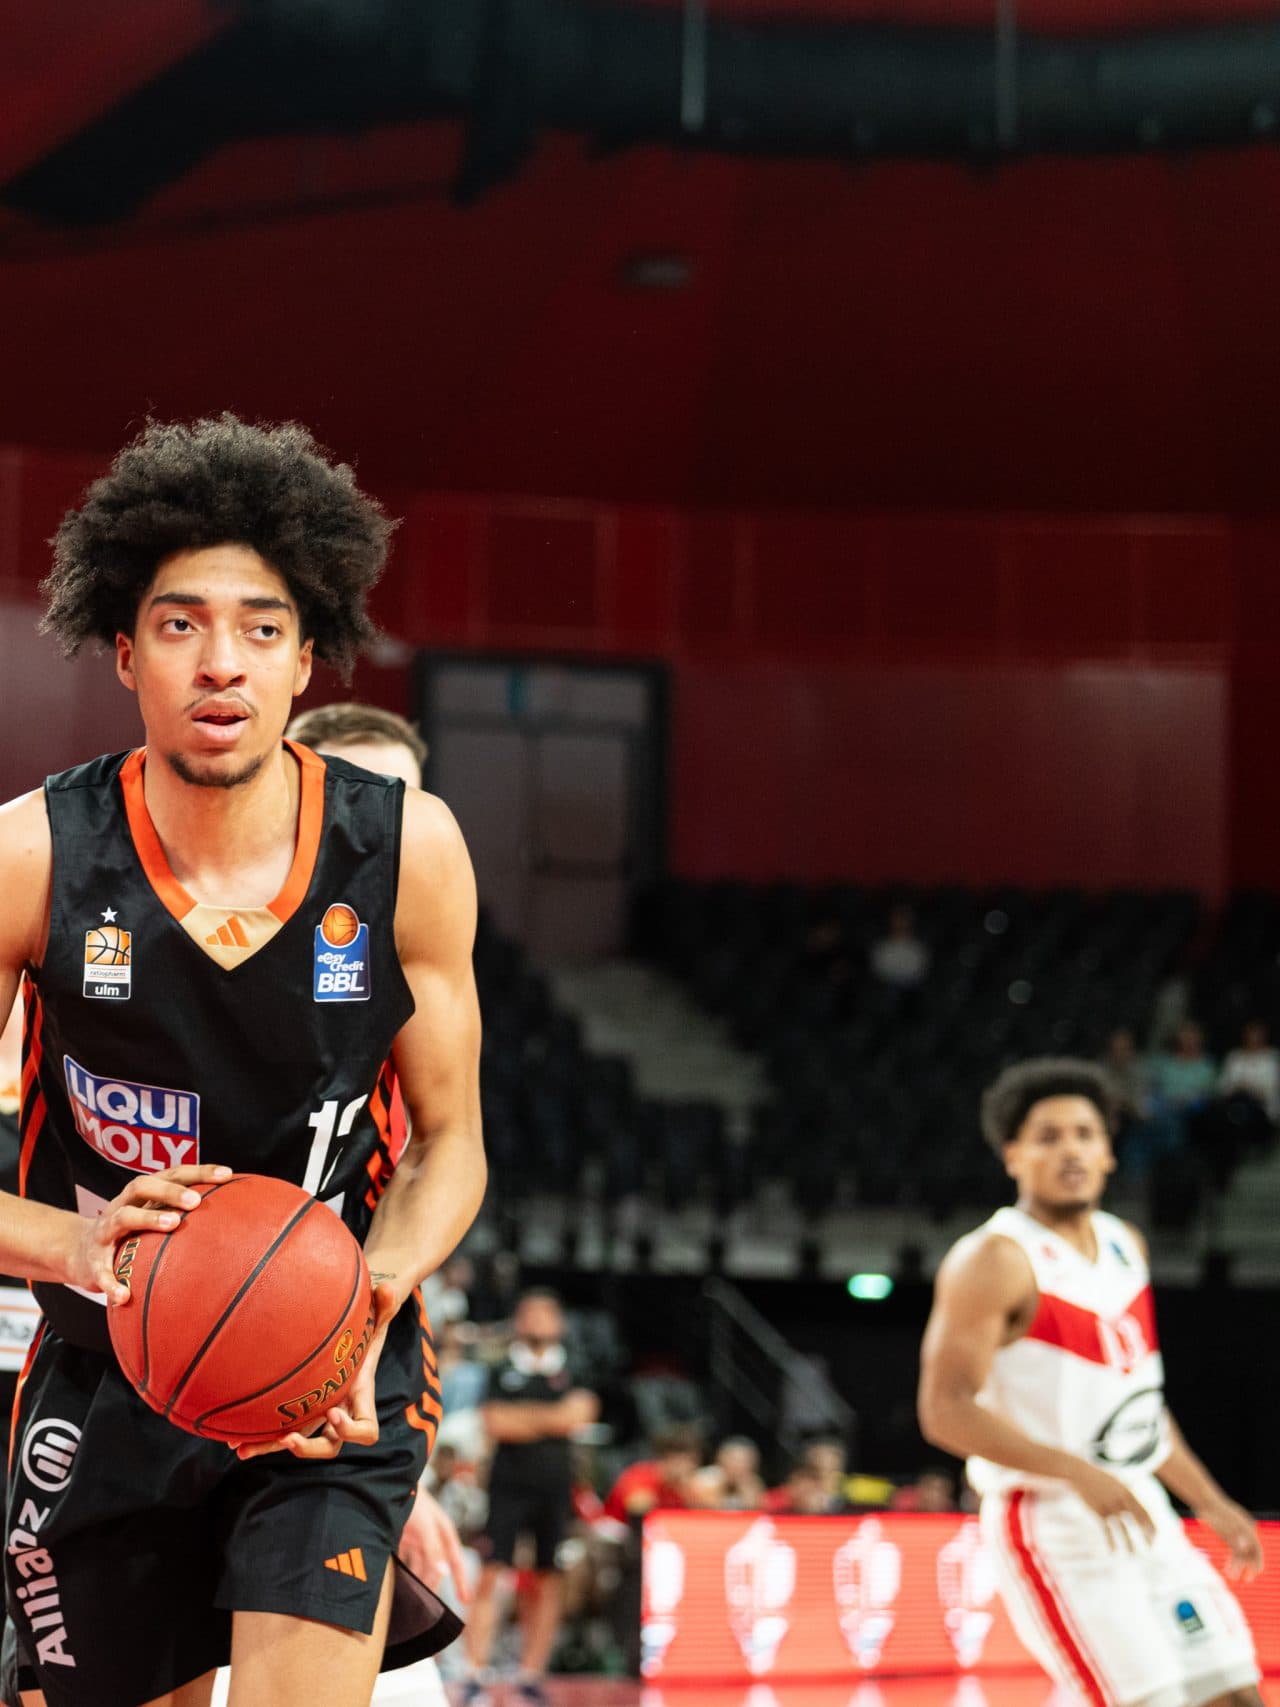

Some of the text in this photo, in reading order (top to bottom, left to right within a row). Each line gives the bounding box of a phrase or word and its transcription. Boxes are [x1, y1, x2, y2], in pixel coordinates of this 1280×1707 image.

[317, 972, 365, 993] BBL
[329, 960, 365, 972] Credit
[94, 984, 120, 996] ulm
[70, 1063, 191, 1133] LIQUI
[75, 1100, 195, 1171] MOLY
[8, 1498, 77, 1668] Allianz
